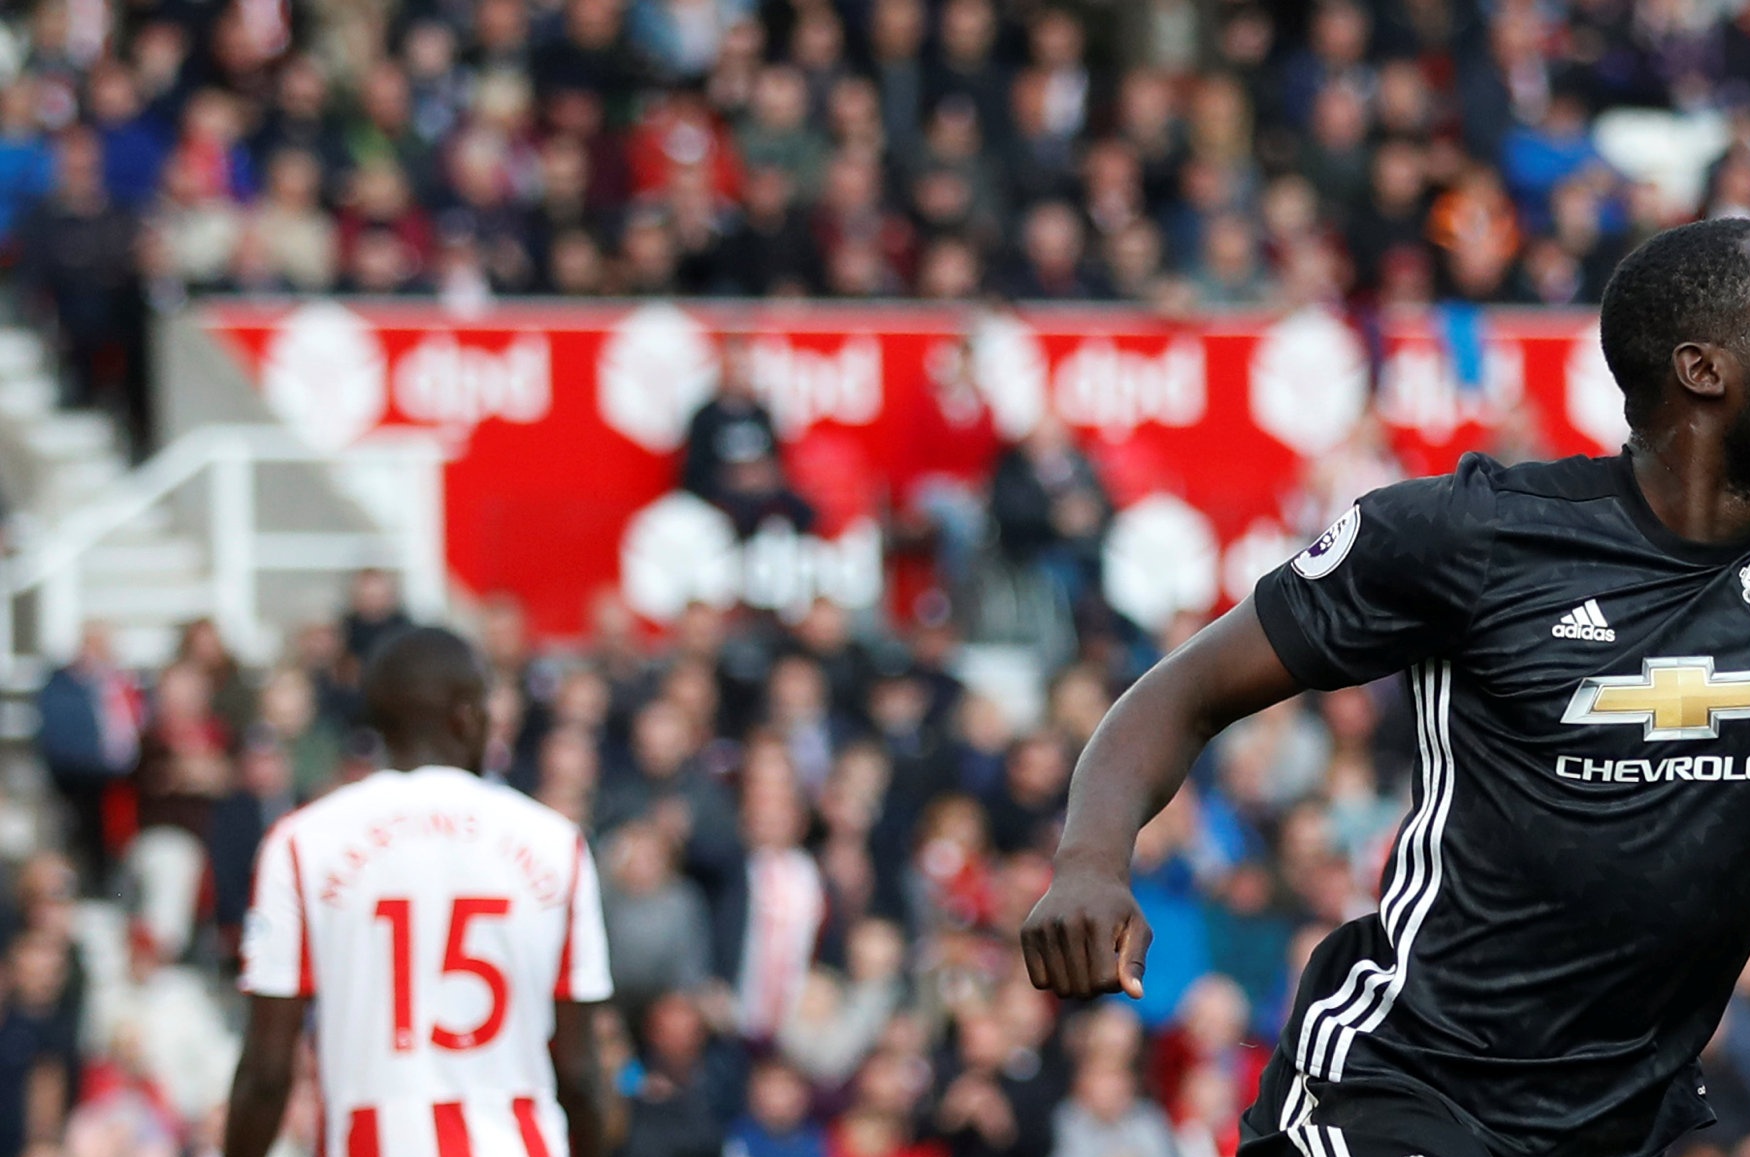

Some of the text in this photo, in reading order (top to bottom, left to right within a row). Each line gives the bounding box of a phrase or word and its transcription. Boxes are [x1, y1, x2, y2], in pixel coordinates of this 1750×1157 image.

[394, 333, 552, 438] dpd
[1054, 335, 1206, 442] dpd
[1551, 622, 1616, 642] adidas
[375, 897, 512, 1052] 15
